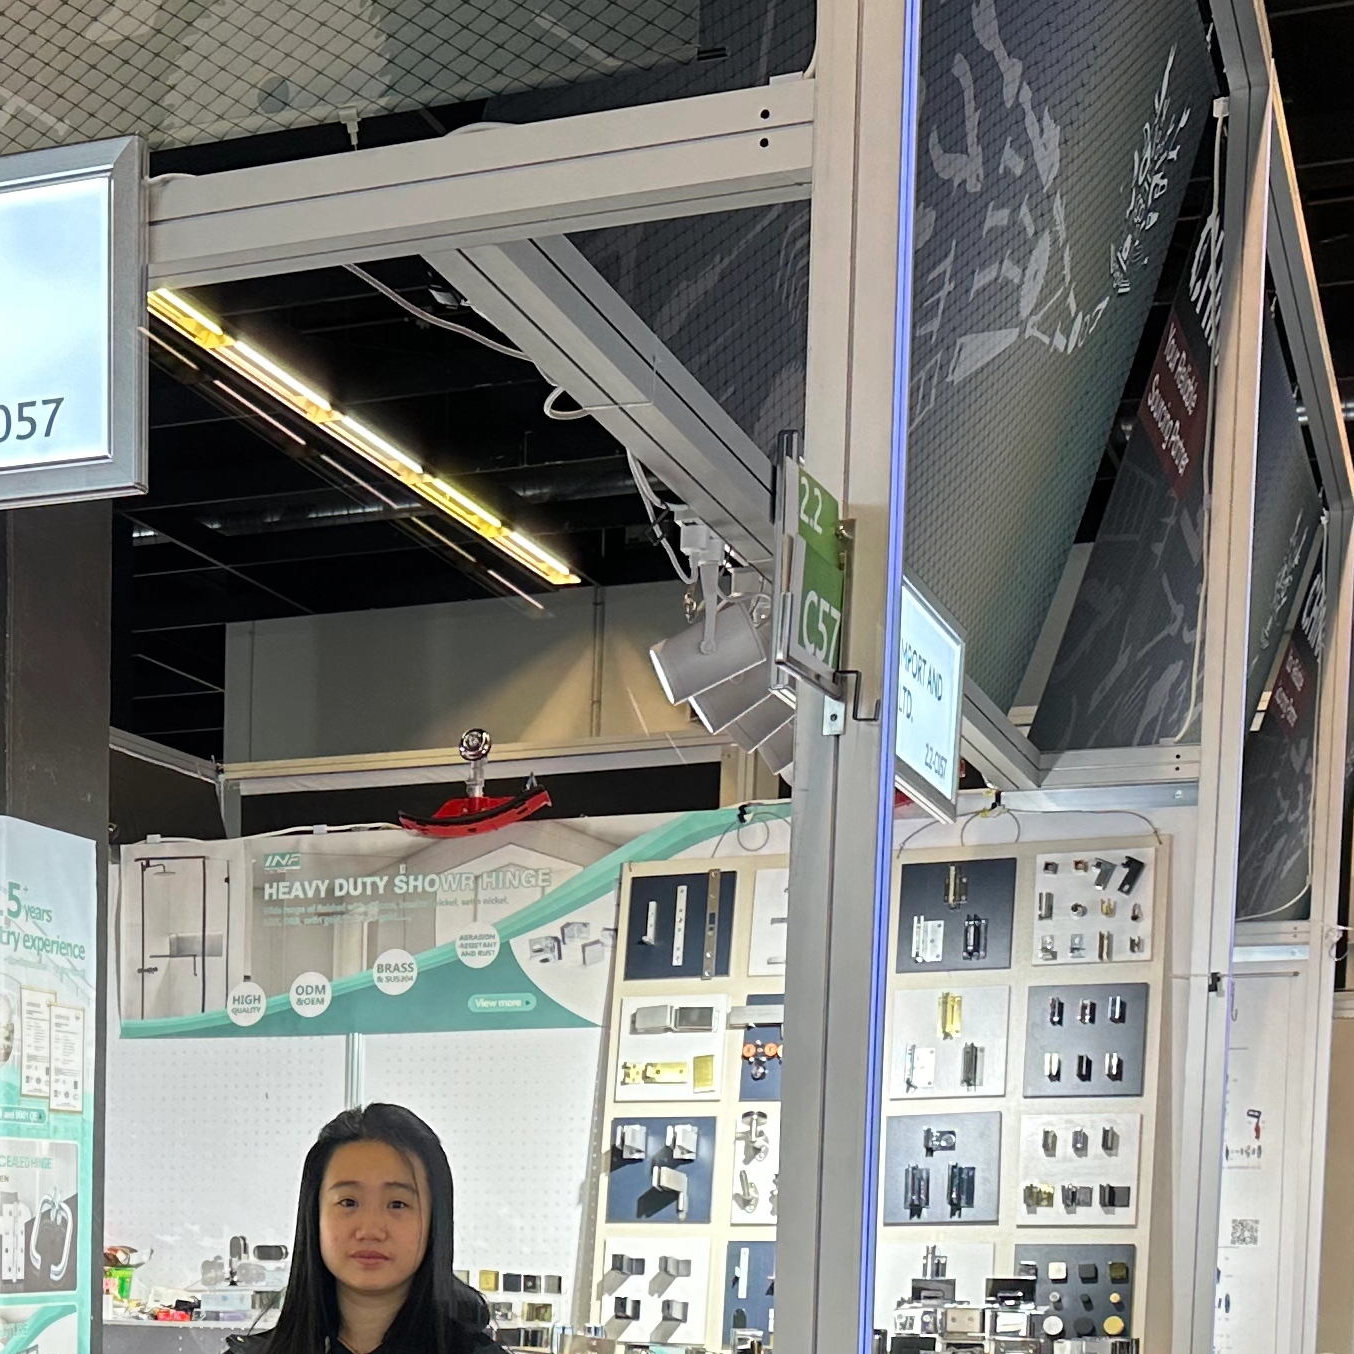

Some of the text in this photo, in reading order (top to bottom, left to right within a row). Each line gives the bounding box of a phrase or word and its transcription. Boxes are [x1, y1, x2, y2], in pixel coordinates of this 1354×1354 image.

[799, 476, 824, 535] 2.2
[802, 589, 842, 667] C57
[927, 663, 943, 702] AND
[264, 853, 302, 867] INF
[263, 868, 552, 901] HEAVY DUTY SHOWR HINGE
[24, 903, 53, 924] years
[22, 933, 86, 961] experience
[376, 962, 414, 974] BRASS
[232, 994, 261, 1006] HIGH
[295, 984, 326, 996] ODM
[231, 1006, 262, 1016] QUALITY
